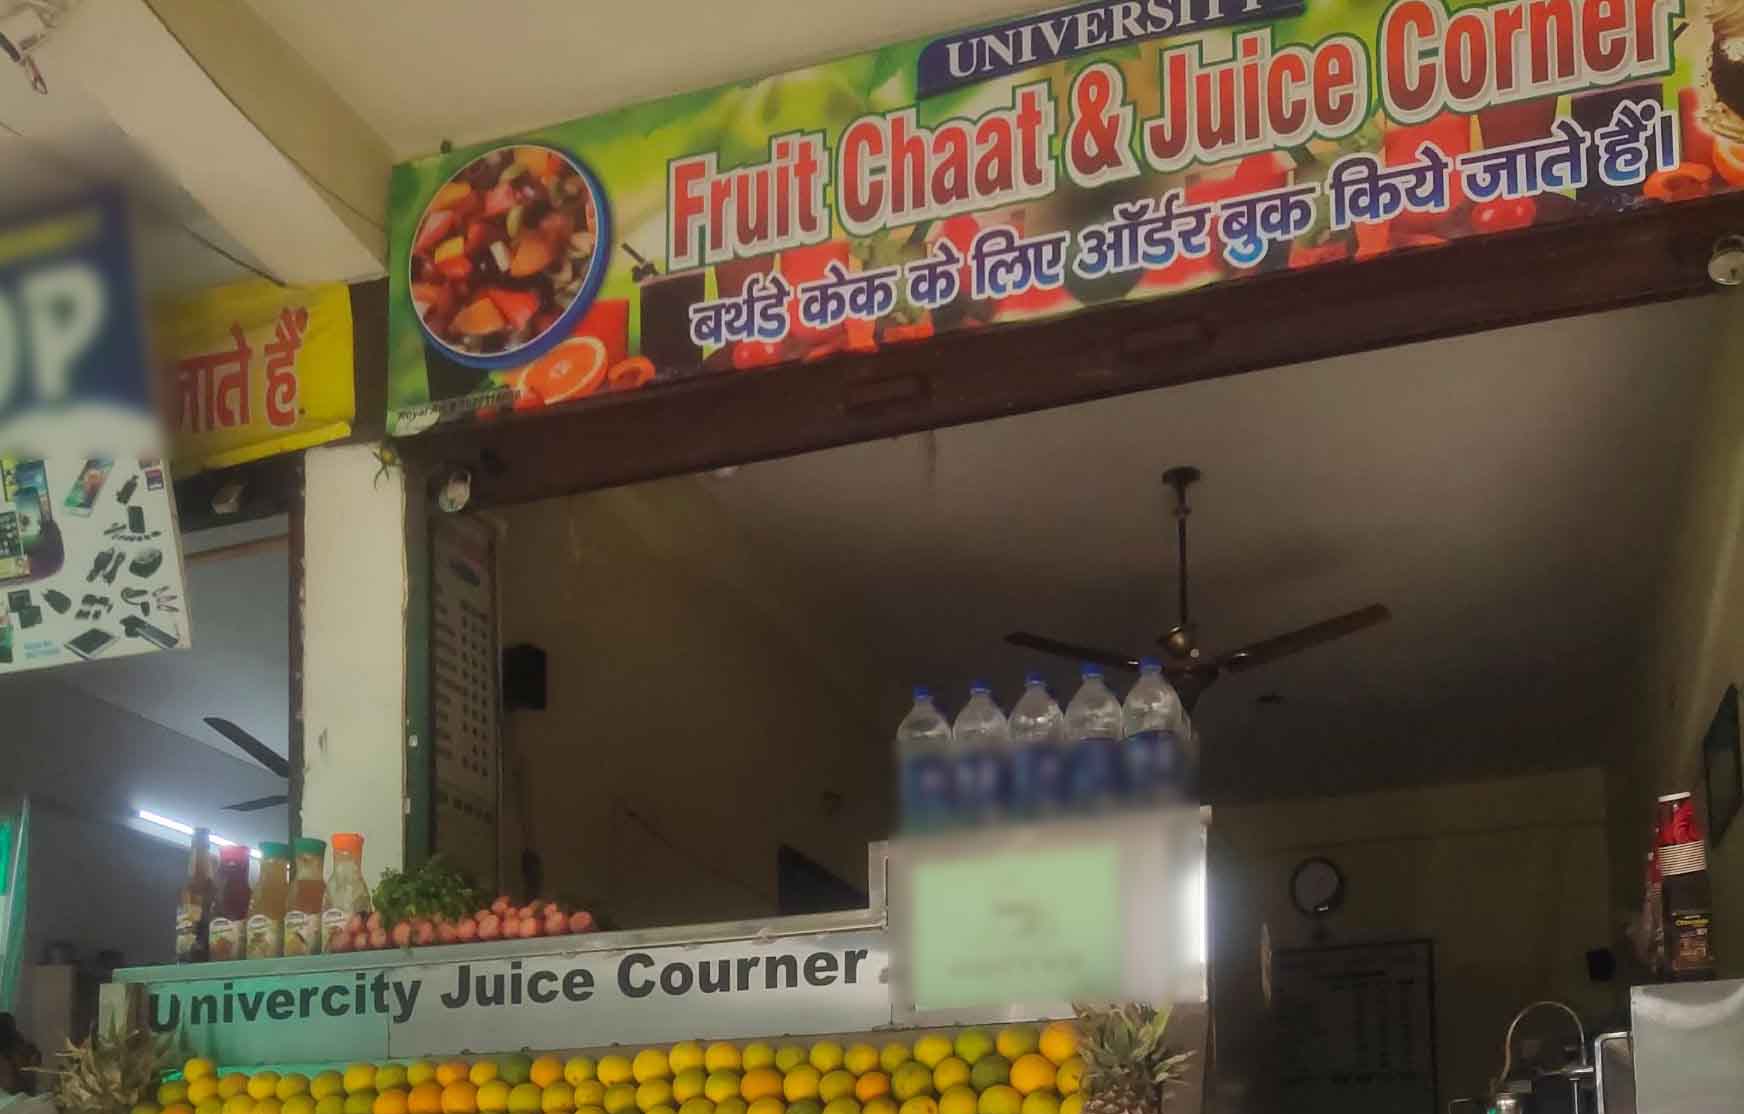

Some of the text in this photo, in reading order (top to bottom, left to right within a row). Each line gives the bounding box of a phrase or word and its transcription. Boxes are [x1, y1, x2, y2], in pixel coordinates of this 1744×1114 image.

[673, 0, 1669, 260] Fruit Chaat & Juice Corner
[801, 262, 898, 325] केक
[909, 242, 961, 304] के
[972, 229, 1066, 296] लिए
[1078, 188, 1212, 275] ऑर्डर
[1218, 185, 1317, 264] बुक
[1329, 147, 1449, 226] किये
[1460, 120, 1586, 198] जाते
[150, 949, 868, 1033] Univercity Juice Courner
